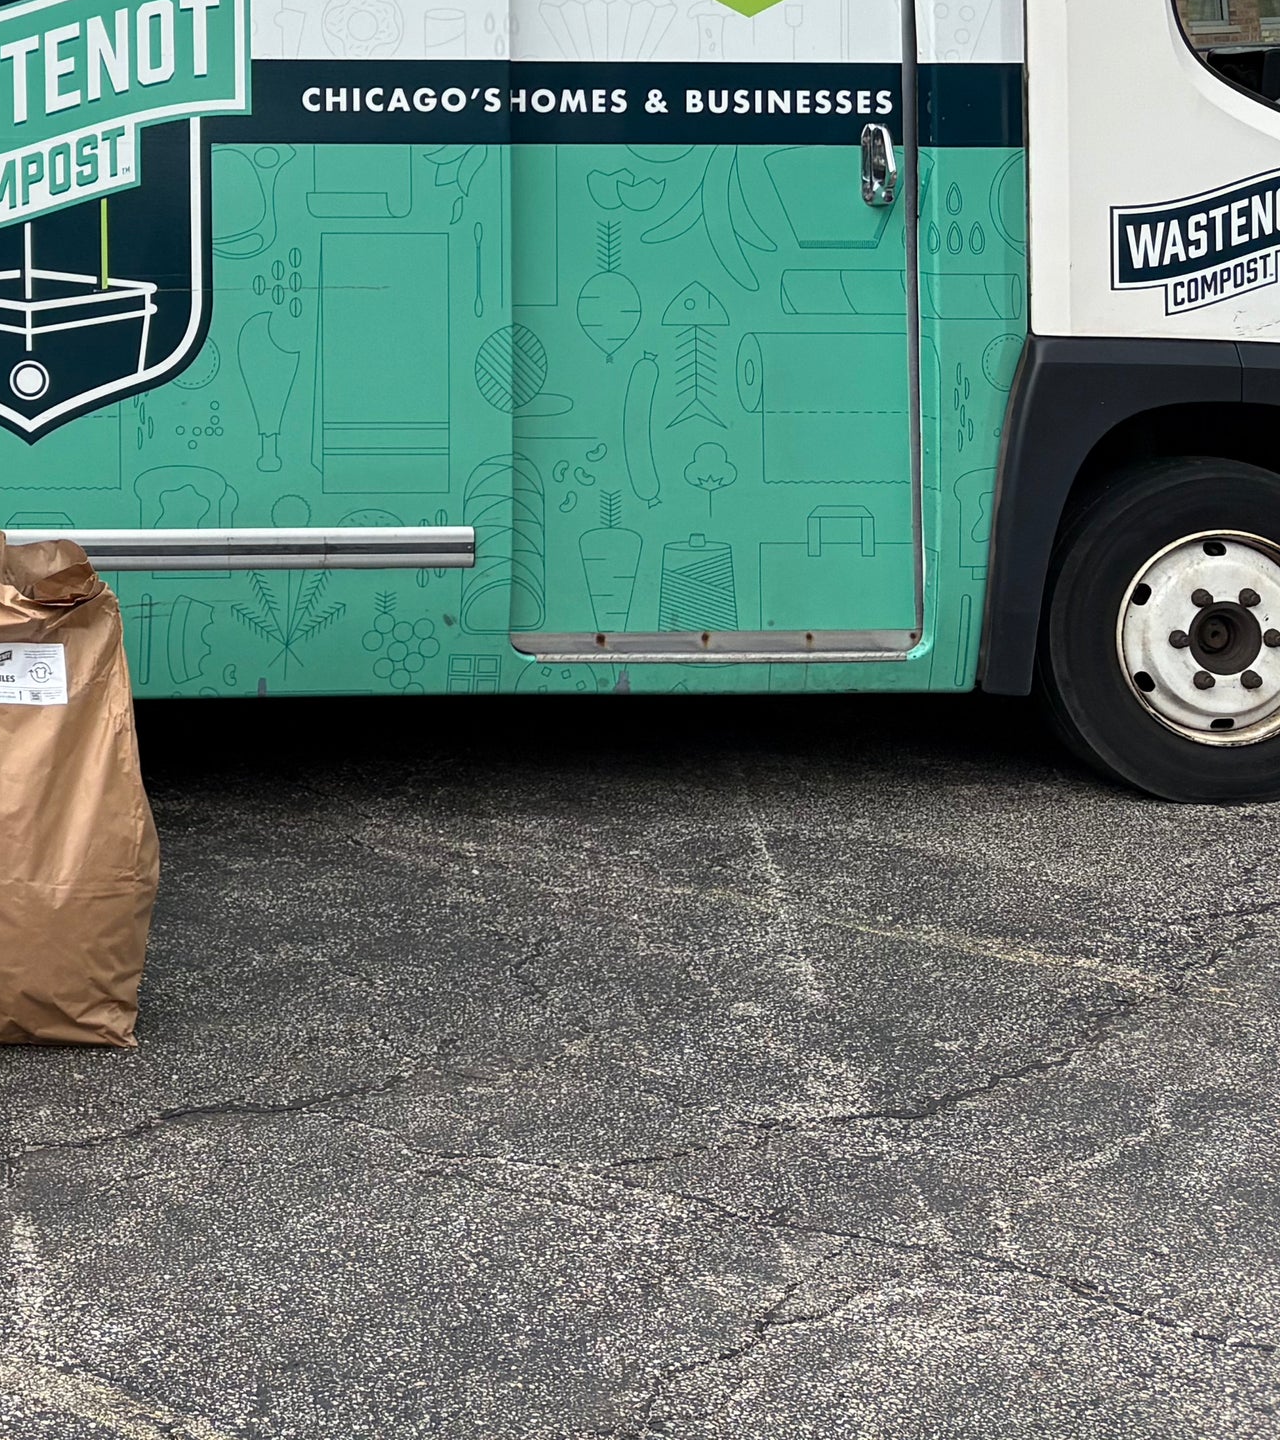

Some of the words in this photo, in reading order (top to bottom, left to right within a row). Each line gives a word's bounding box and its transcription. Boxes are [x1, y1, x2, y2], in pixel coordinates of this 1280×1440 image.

[303, 88, 501, 112] CHICAGO'S
[510, 89, 627, 113] HOMES
[645, 89, 668, 113] &
[687, 90, 892, 114] BUSINESSES
[1126, 188, 1280, 269] WASTEN
